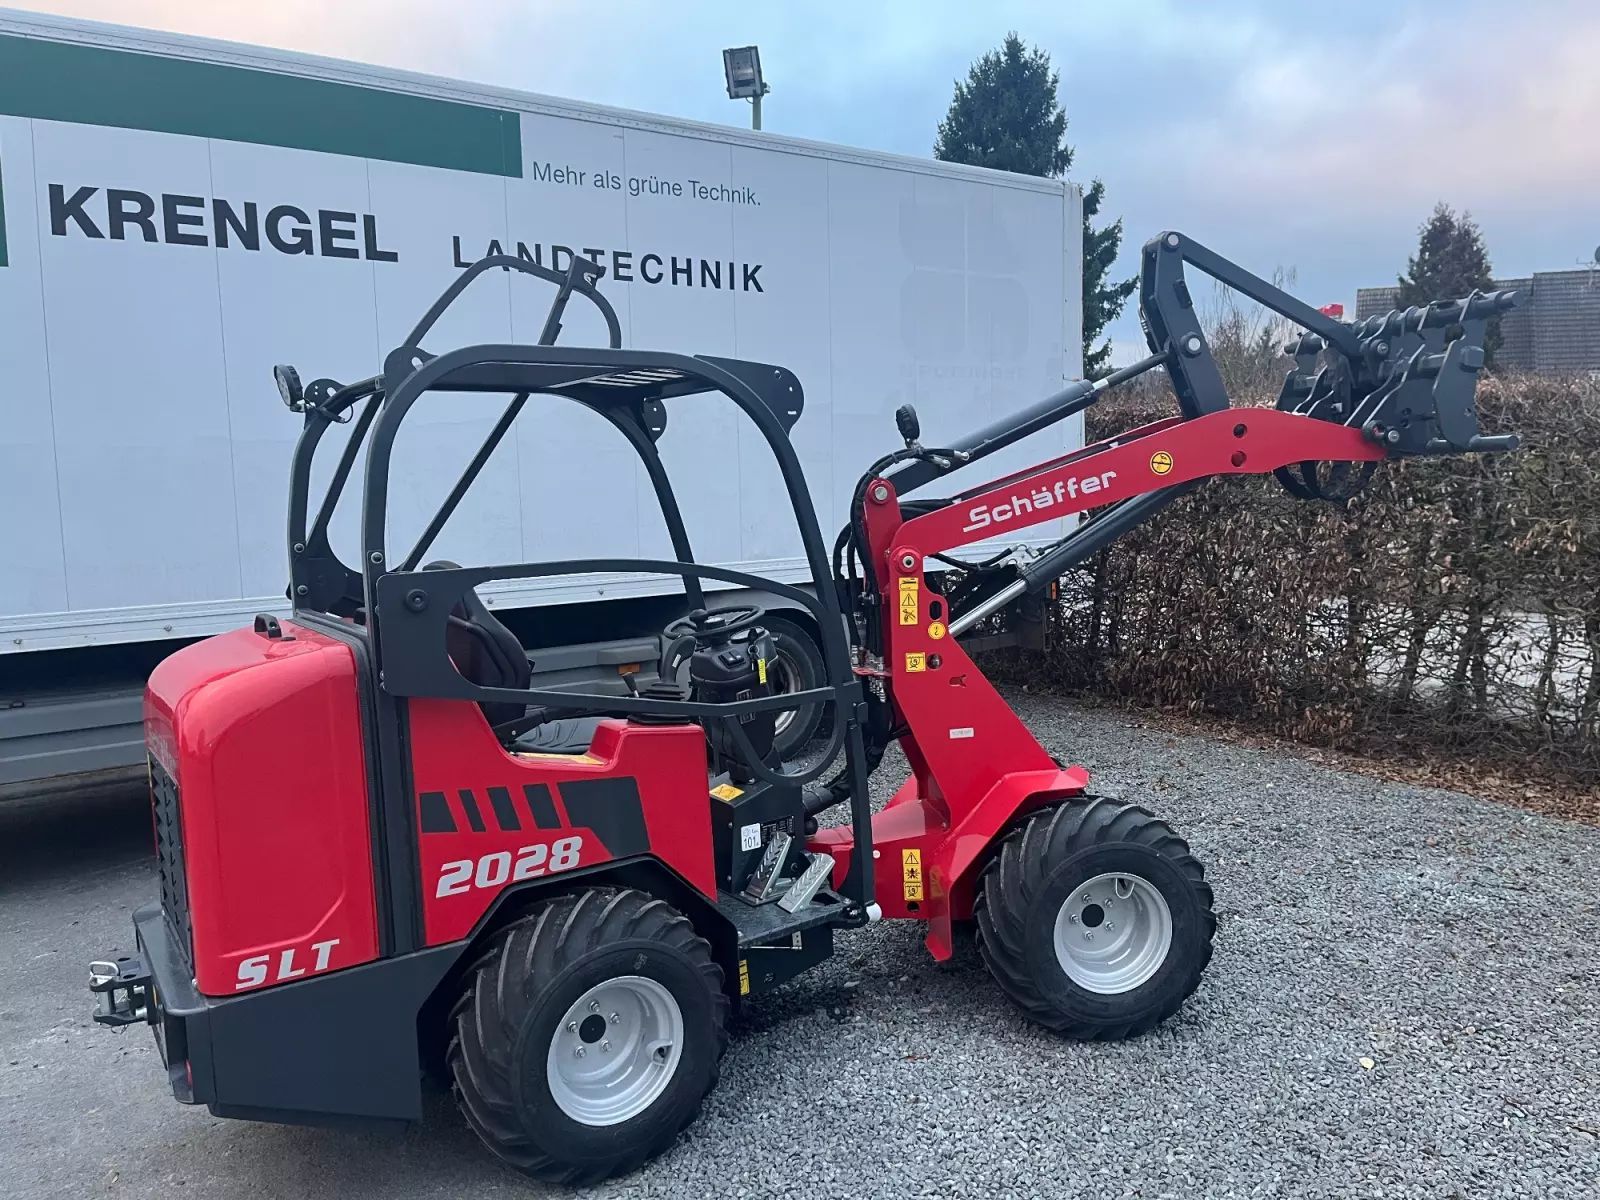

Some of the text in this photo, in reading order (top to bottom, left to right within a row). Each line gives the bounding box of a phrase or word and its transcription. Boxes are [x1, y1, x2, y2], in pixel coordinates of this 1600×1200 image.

[533, 161, 761, 206] Mehr als grüne Technik.
[48, 183, 398, 263] KRENGEL
[962, 470, 1117, 533] Schäffer
[435, 836, 583, 899] 2028
[743, 836, 756, 849] 101
[235, 939, 340, 990] SLT
